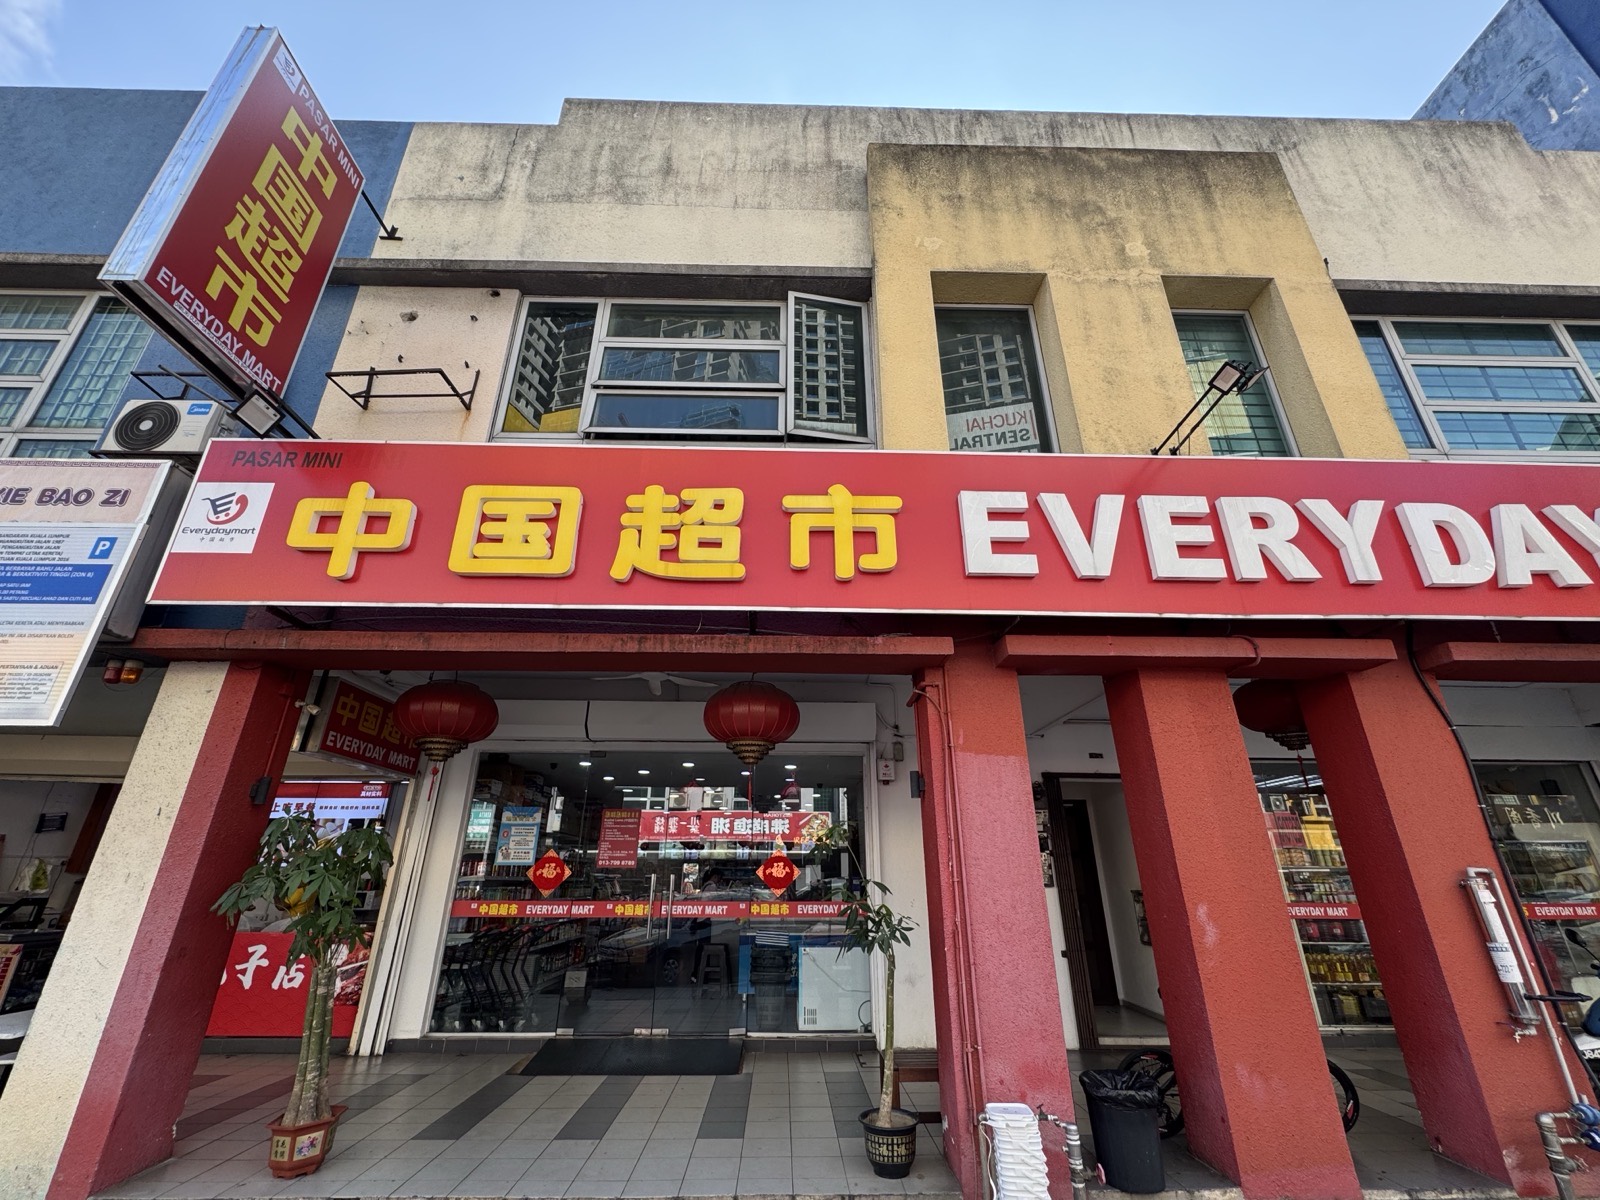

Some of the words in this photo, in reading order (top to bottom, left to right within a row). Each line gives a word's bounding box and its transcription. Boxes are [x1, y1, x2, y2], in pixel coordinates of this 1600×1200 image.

[299, 84, 338, 152] PASAR
[337, 149, 360, 190] MINI
[205, 105, 338, 347] 中国超市
[156, 266, 243, 354] EVERYDAY
[242, 350, 282, 393] MART
[231, 451, 298, 468] PASAR
[301, 452, 343, 468] MINI
[35, 487, 94, 507] BAO
[99, 488, 131, 507] ZI
[182, 527, 256, 536] Everydaymart
[286, 481, 904, 581] 中国超市
[325, 730, 387, 761] EVERYDAY
[387, 750, 416, 770] MART
[479, 904, 519, 915] 中国超市
[526, 905, 569, 915] EVERYDAY
[571, 905, 595, 915] MART
[704, 905, 728, 915] MART
[750, 904, 790, 915] 中国超市
[797, 904, 839, 914] EVERYDAY
[1327, 907, 1348, 916] MART
[1535, 906, 1575, 916] EVERYDAY
[1575, 906, 1597, 916] MART
[220, 944, 305, 990] 子店
